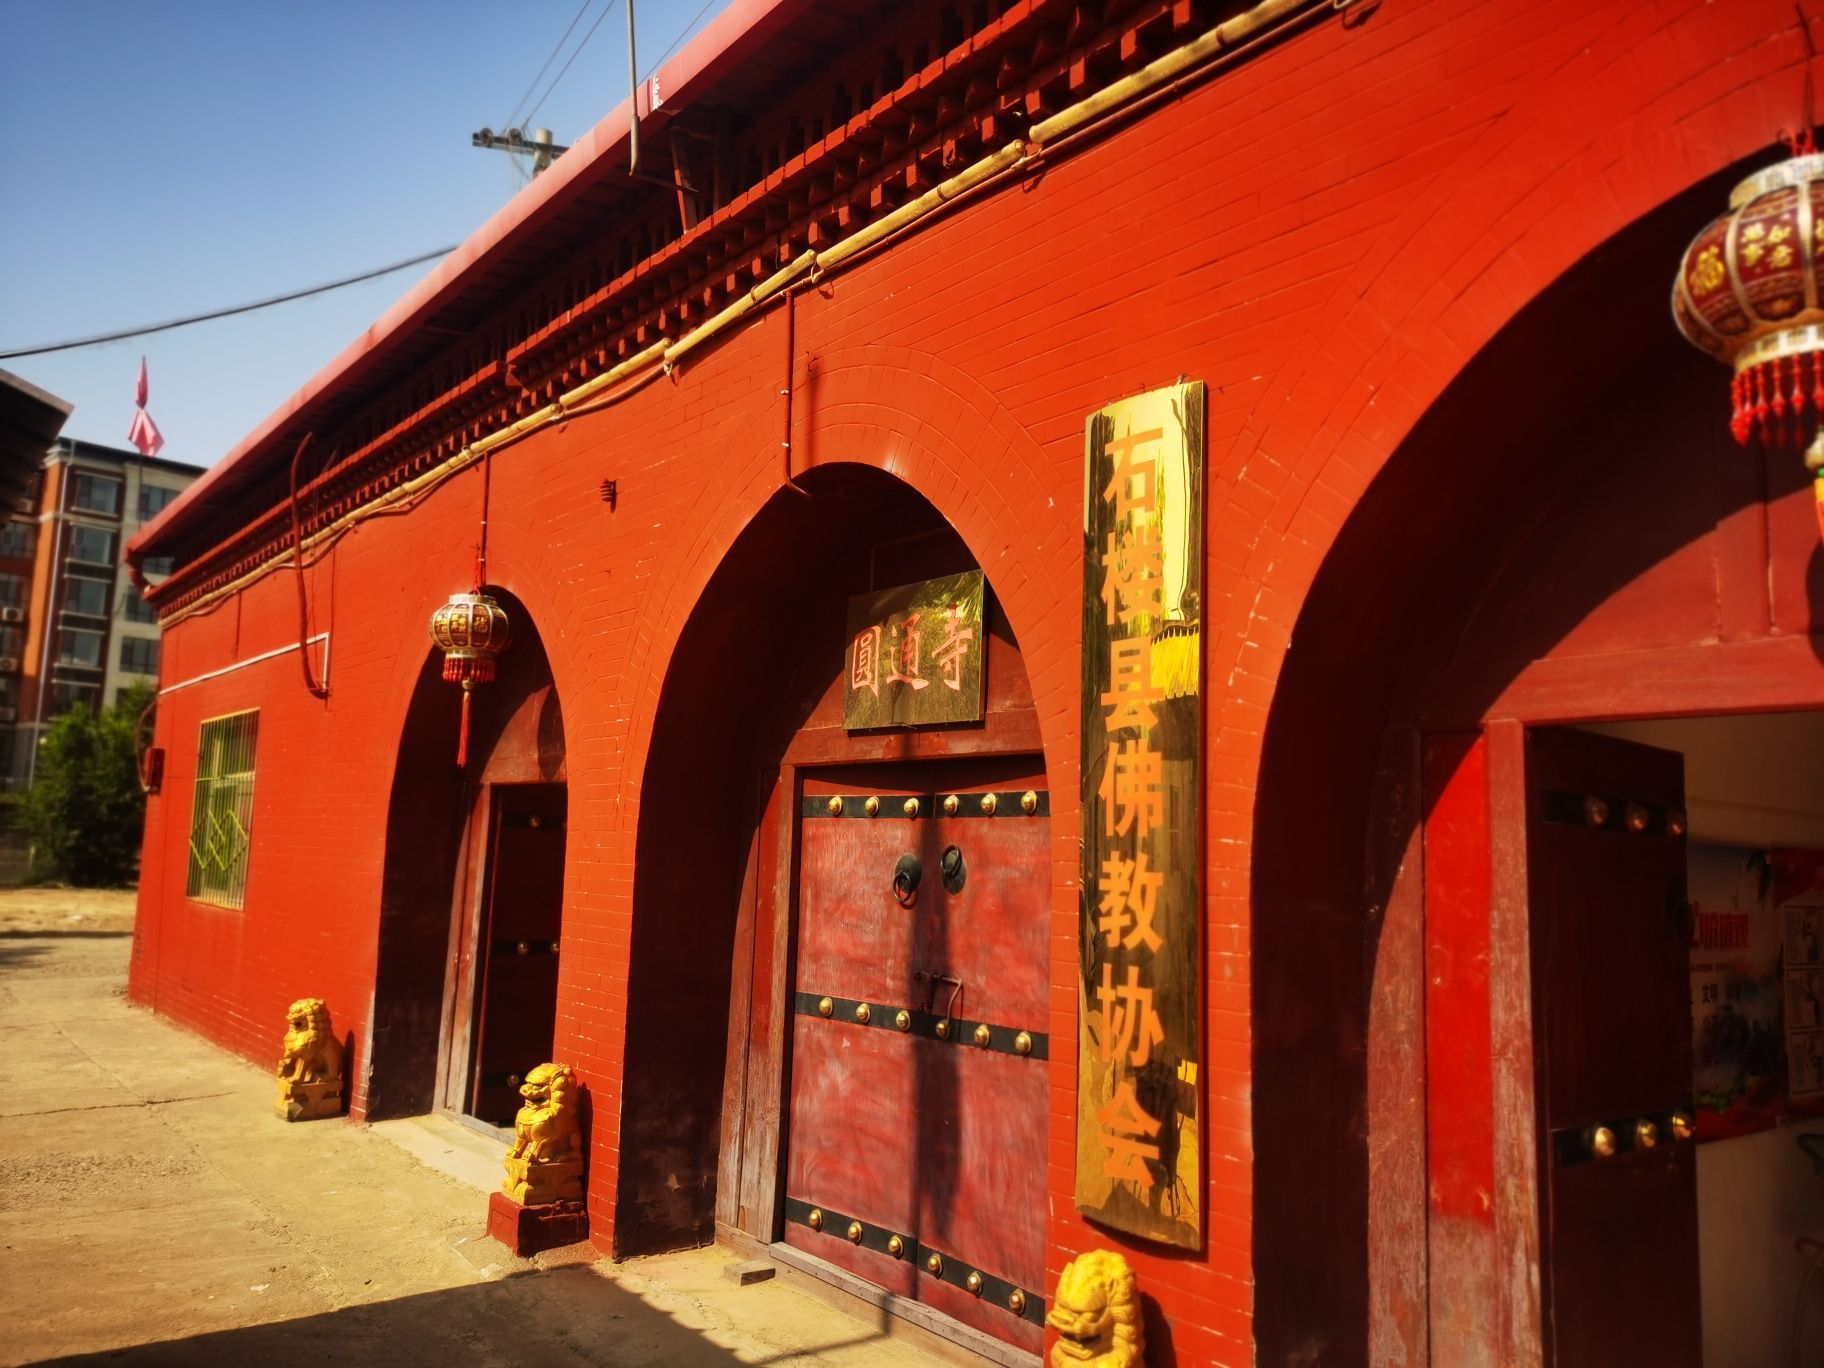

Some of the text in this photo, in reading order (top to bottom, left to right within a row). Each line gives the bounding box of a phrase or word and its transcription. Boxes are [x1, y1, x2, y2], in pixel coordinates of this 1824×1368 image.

[1097, 426, 1165, 1190] 石楼县佛教协会
